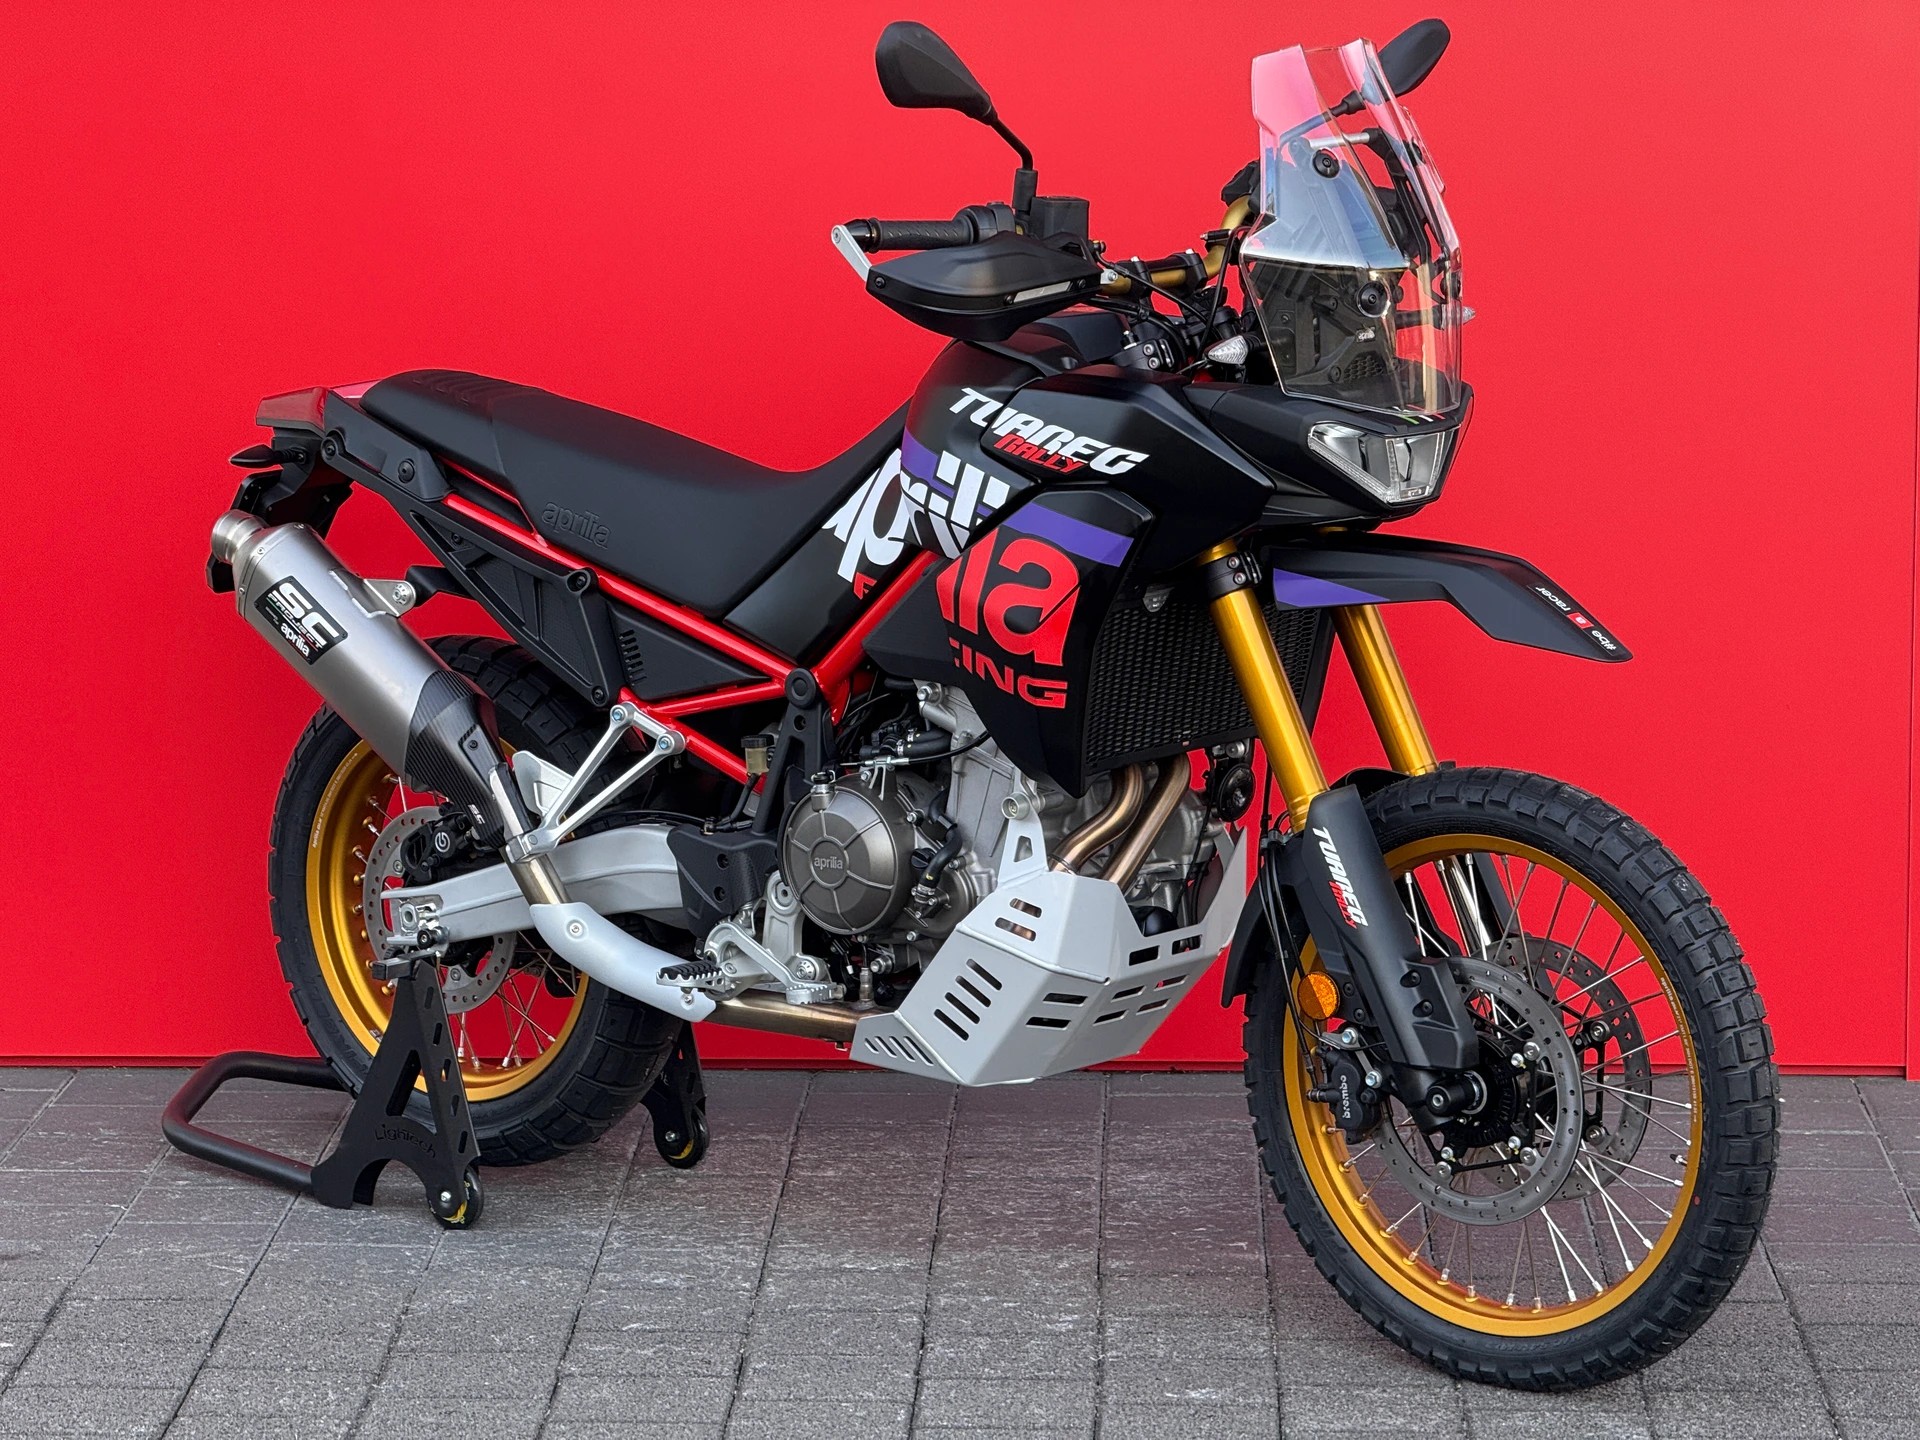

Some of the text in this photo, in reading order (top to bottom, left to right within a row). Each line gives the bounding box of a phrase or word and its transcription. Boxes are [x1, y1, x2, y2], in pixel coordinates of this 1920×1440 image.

[949, 387, 1150, 475] TUAREG
[993, 432, 1086, 474] RALLY
[541, 501, 611, 550] aprilia
[266, 592, 324, 649] PROJECT
[271, 582, 340, 648] SC
[1535, 586, 1572, 612] racer
[280, 622, 311, 657] aprilia
[1591, 630, 1617, 651] #be
[813, 855, 844, 871] aprilia
[1312, 826, 1369, 927] TUAREG
[1339, 1074, 1352, 1119] brembo
